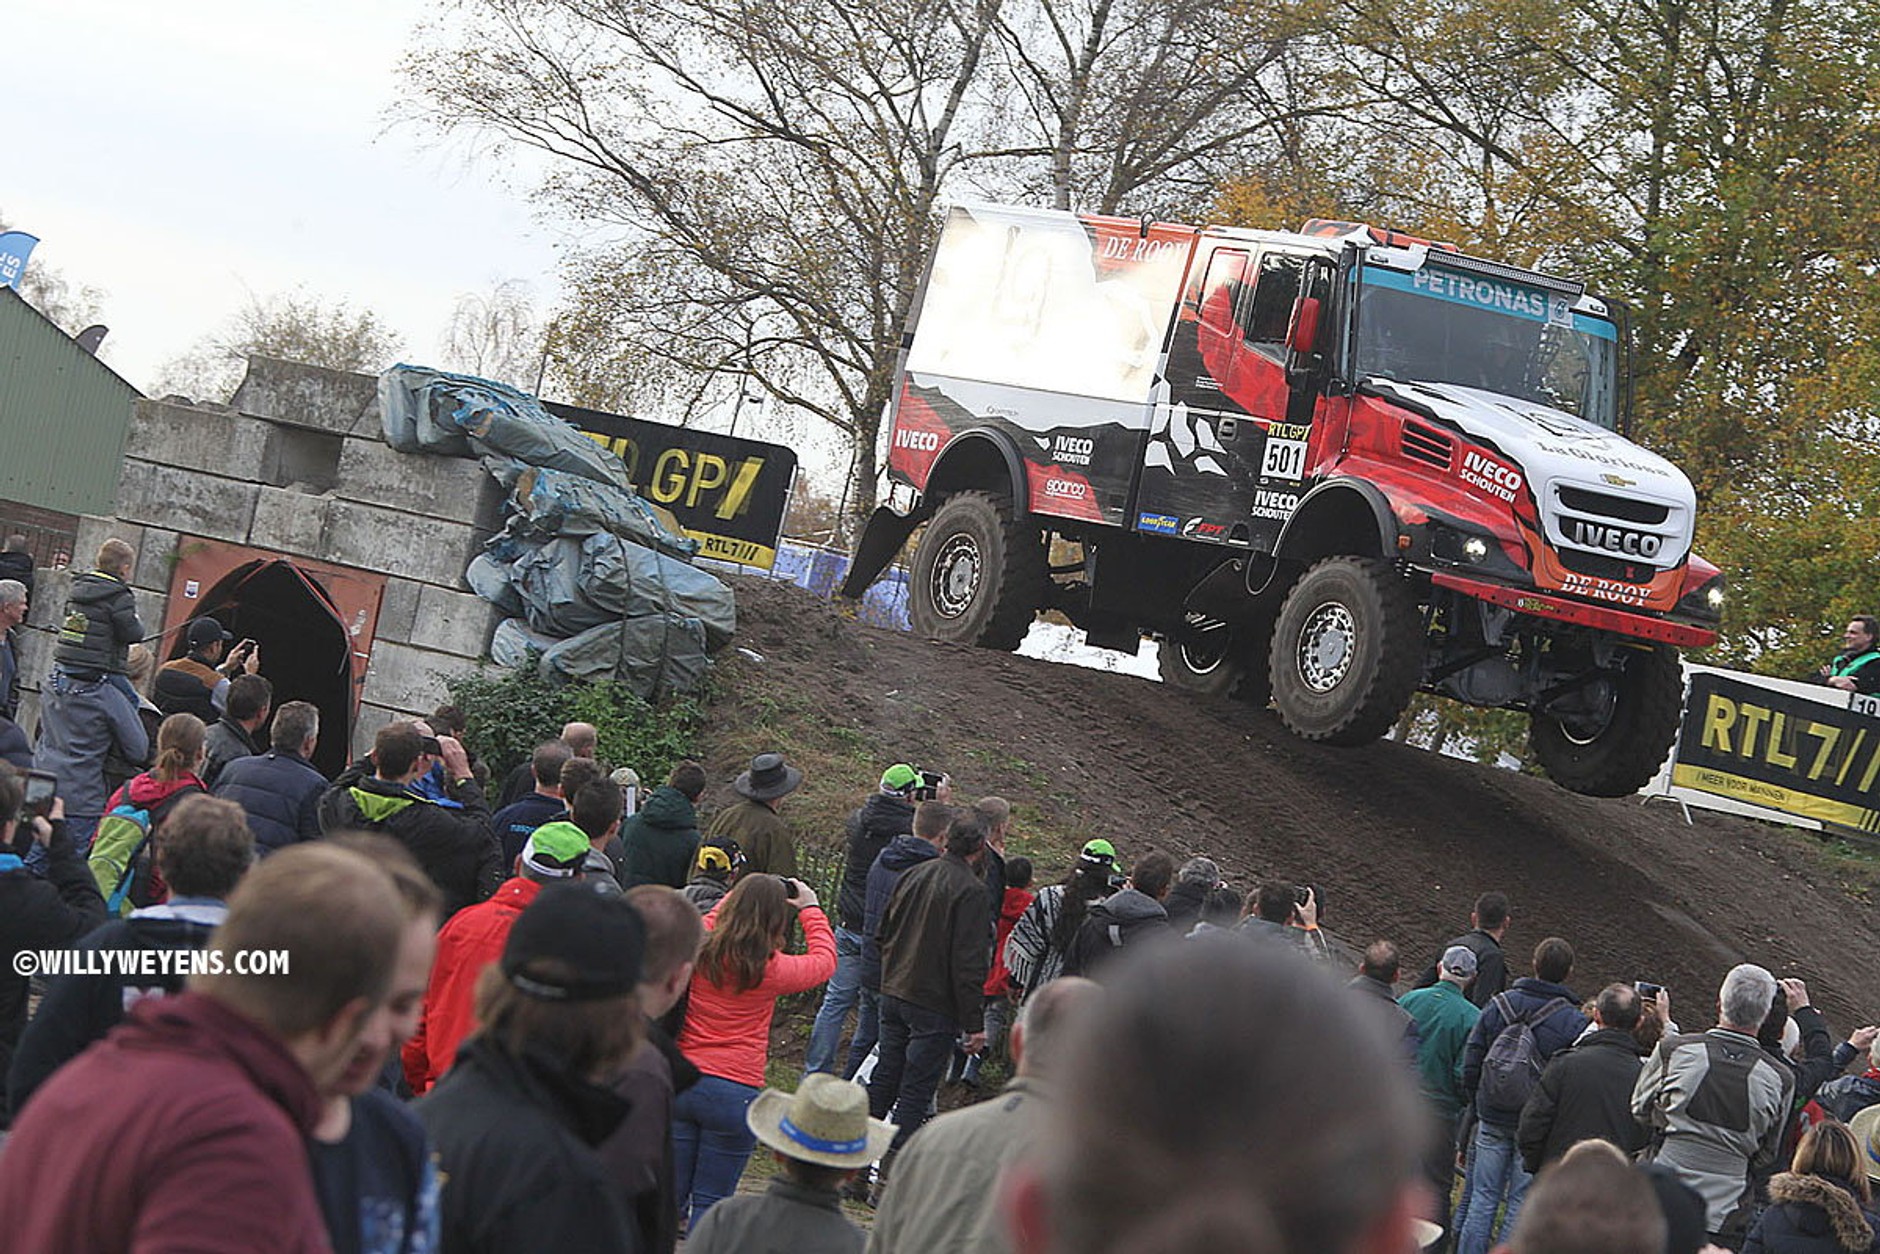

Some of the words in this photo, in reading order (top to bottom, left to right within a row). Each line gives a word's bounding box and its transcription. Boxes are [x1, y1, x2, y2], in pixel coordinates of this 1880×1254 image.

[1104, 236, 1132, 259] DE
[1413, 269, 1545, 316] PETRONAS
[894, 428, 938, 451] IVECO
[1054, 435, 1094, 455] IVECO
[1267, 444, 1301, 475] 501
[1463, 451, 1522, 491] IVECO
[1045, 479, 1085, 499] sparco
[1458, 468, 1517, 503] SCHOUTEN
[1254, 490, 1299, 511] IVECO
[1250, 506, 1292, 521] SCHOUTE
[1197, 523, 1227, 535] FPT
[1574, 521, 1661, 559] IVECO
[1560, 573, 1592, 596] DE
[1592, 579, 1652, 607] ROOY
